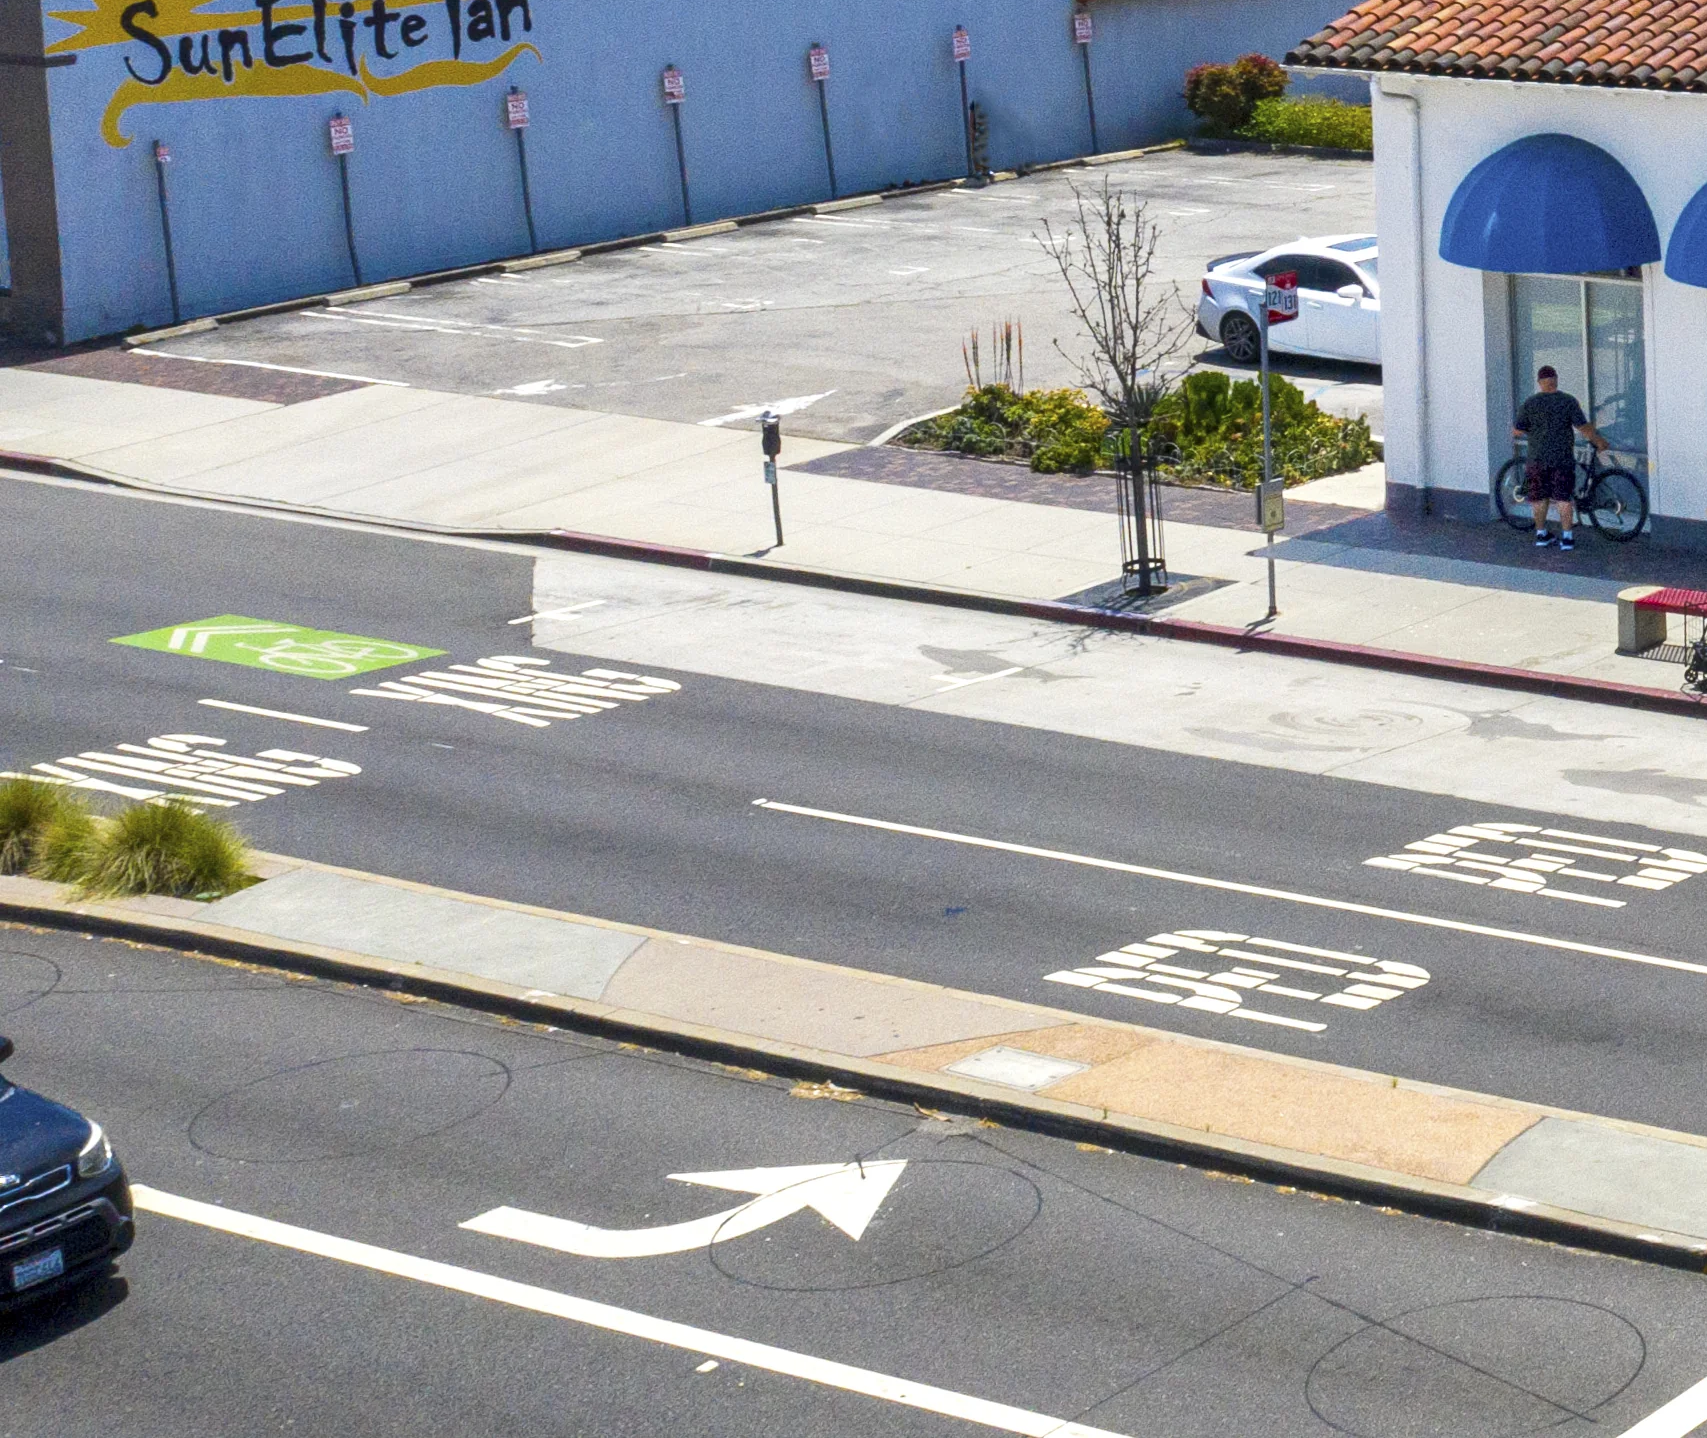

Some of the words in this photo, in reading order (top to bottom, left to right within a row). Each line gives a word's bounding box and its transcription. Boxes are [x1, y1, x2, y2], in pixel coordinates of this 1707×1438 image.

[1268, 290, 1282, 306] 121
[1284, 294, 1297, 310] 131
[349, 655, 682, 728] XING
[1042, 929, 1431, 1032] PED
